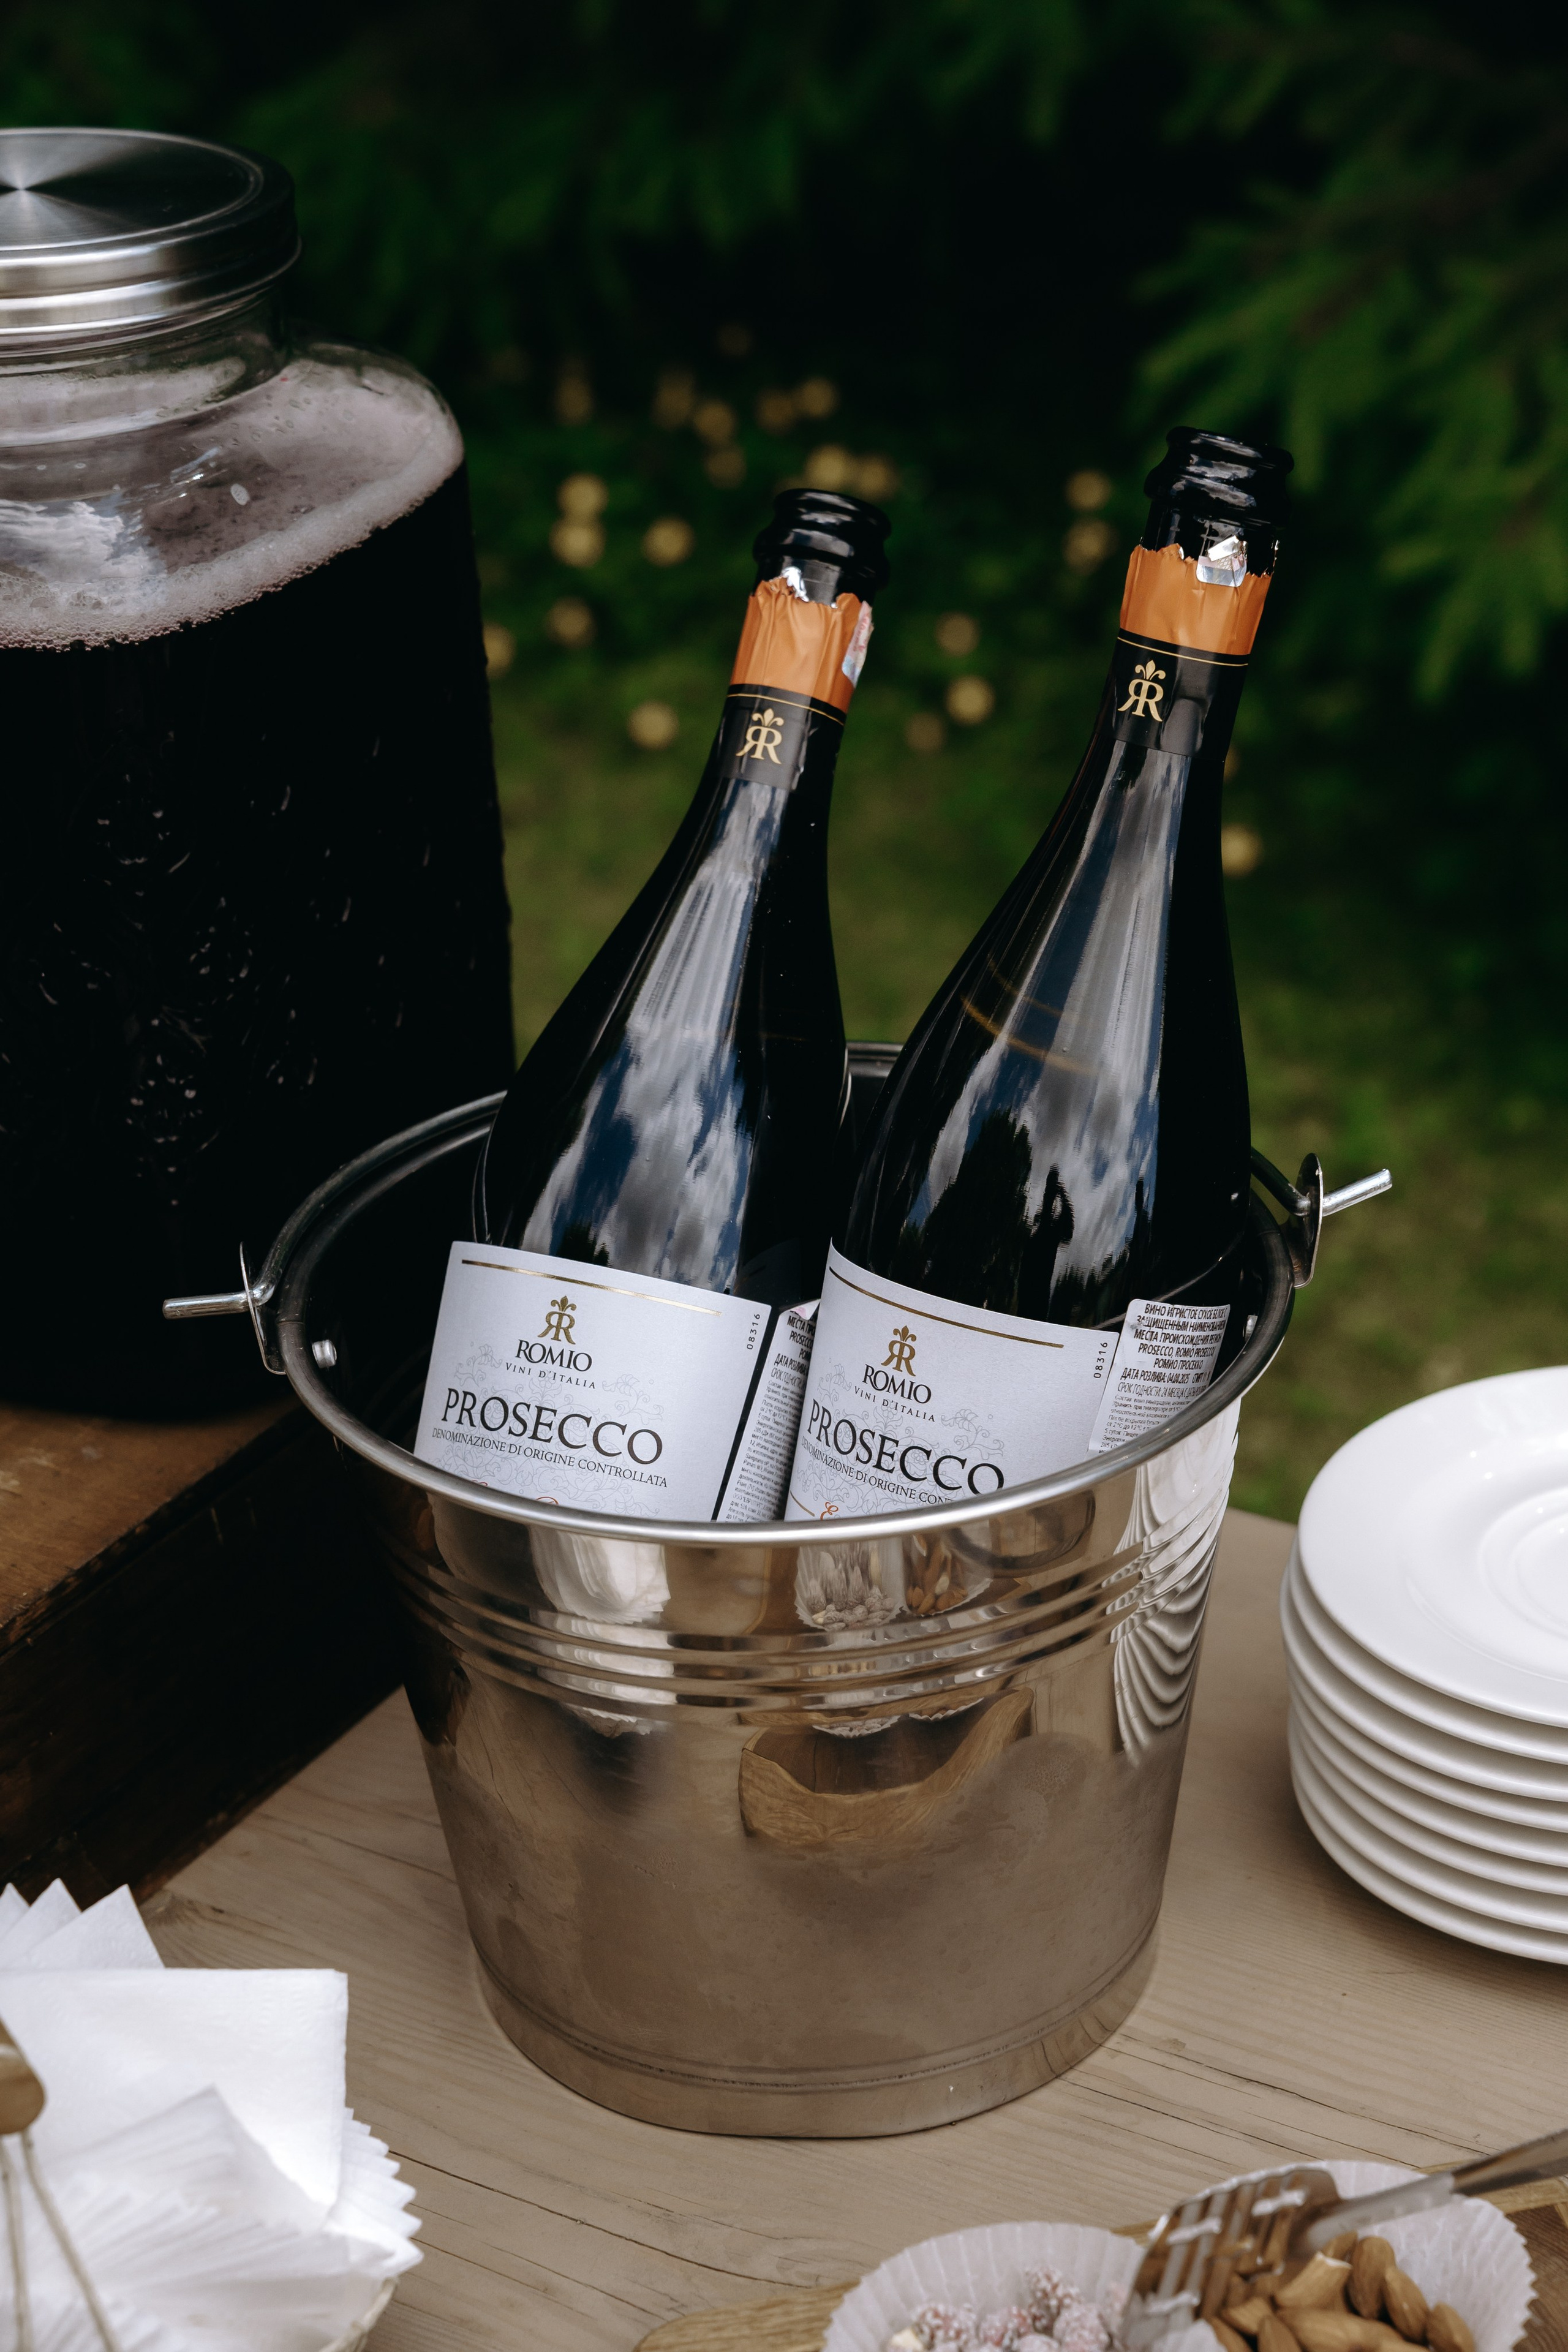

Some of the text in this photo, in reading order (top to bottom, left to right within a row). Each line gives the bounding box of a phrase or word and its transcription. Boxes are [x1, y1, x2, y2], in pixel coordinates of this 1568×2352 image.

[1144, 1303, 1166, 1316] ВИНО
[1167, 1306, 1197, 1320] ИГРИСТОЕ
[747, 1314, 760, 1350] 08316
[1134, 1329, 1158, 1342] МЕСТА
[1159, 1332, 1209, 1348] ПРОИСХОЖДЕНИЯ
[515, 1339, 592, 1372] ROMIO
[1093, 1343, 1107, 1378] 08316
[1138, 1343, 1174, 1358] PROSECCO,
[1175, 1347, 1194, 1358] ROMIO
[1153, 1358, 1178, 1369] РОМИО
[506, 1362, 595, 1389] VINI D'ITALIA
[862, 1364, 932, 1404] ROMIO
[1117, 1382, 1133, 1393] СРОК
[1120, 1367, 1139, 1380] ДАТА
[854, 1386, 935, 1422] VINI D'ITALIA
[441, 1387, 663, 1464] PROSECCO
[432, 1428, 668, 1488] DENOMINAZIONE DI ORIGINE CONTROLLATA
[807, 1398, 1005, 1496] PROSECCO
[801, 1436, 854, 1477] DENOMINAZIONE
[855, 1471, 867, 1483] DI
[869, 1476, 916, 1499] ORIGINE
